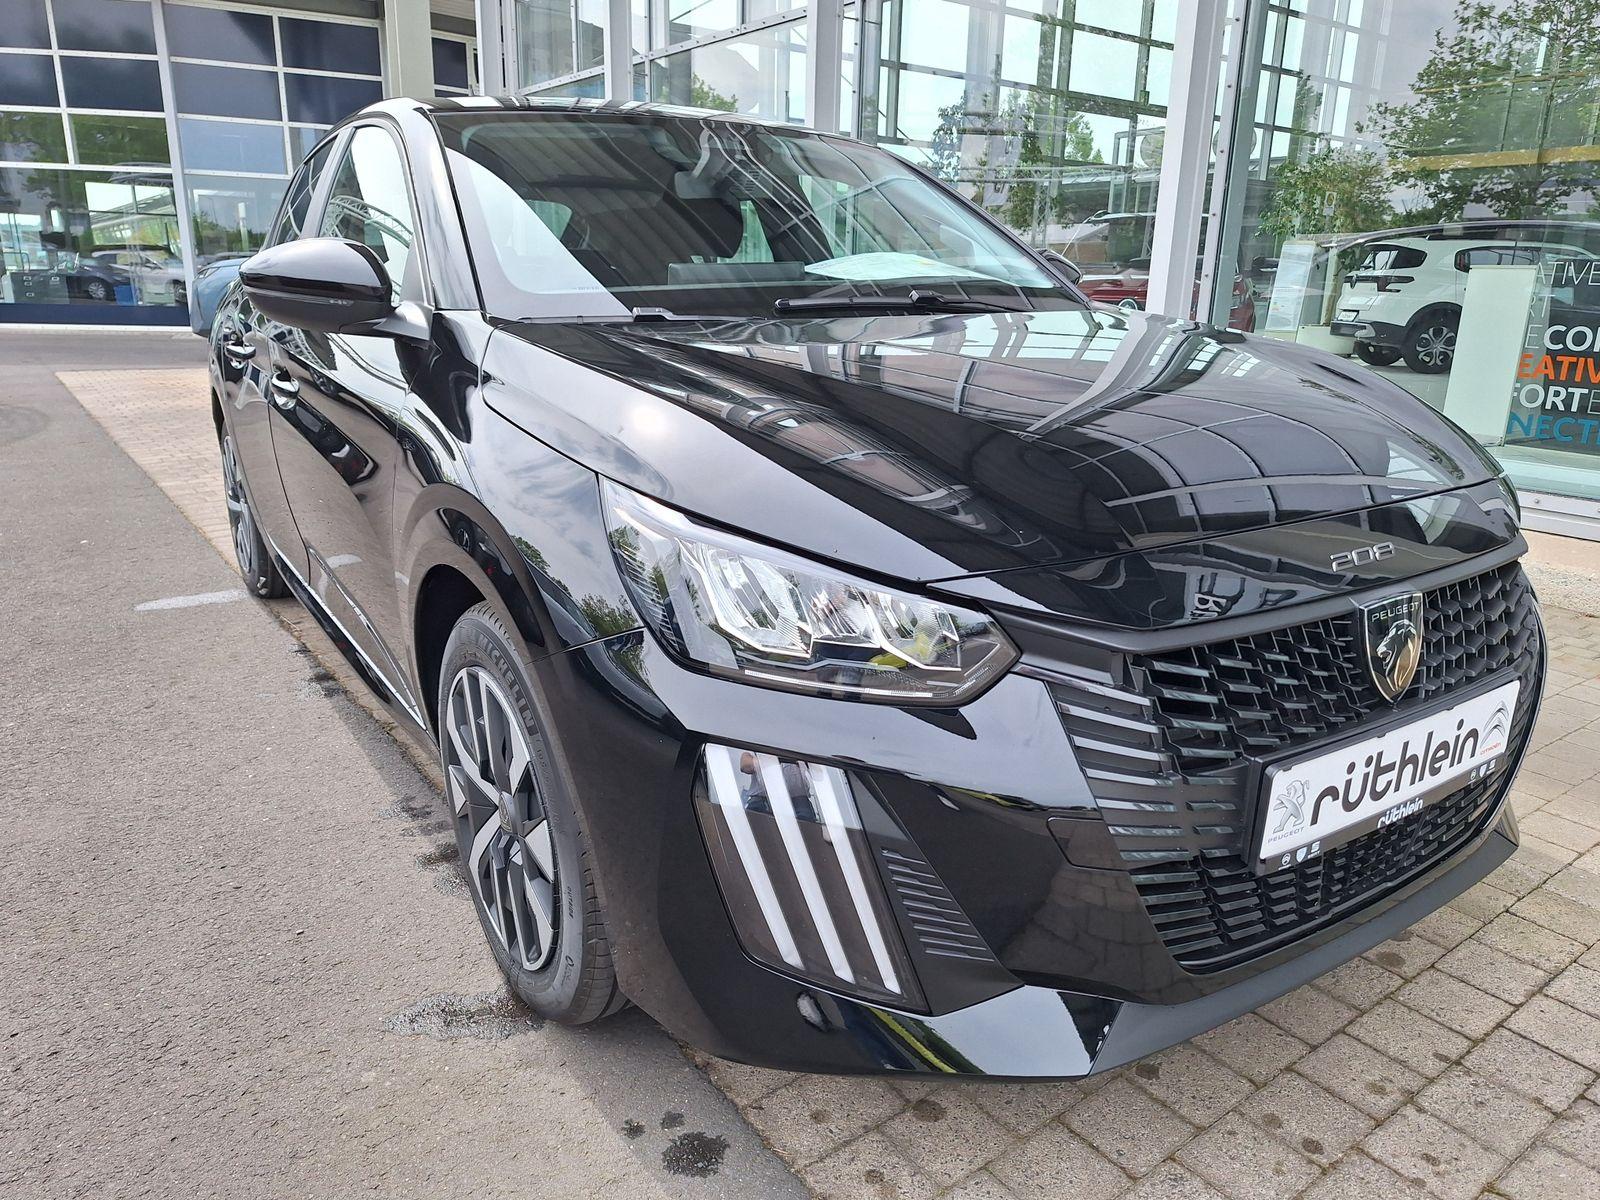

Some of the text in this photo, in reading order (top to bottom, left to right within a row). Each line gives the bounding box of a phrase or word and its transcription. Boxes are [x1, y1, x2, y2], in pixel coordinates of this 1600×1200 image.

[1330, 541, 1395, 572] 208
[1371, 601, 1419, 623] PEUGEOT
[477, 632, 535, 729] MICHELIN
[1309, 718, 1479, 827] rüthlein
[1377, 797, 1424, 829] rüthlein
[1267, 826, 1305, 844] PEUGEOT
